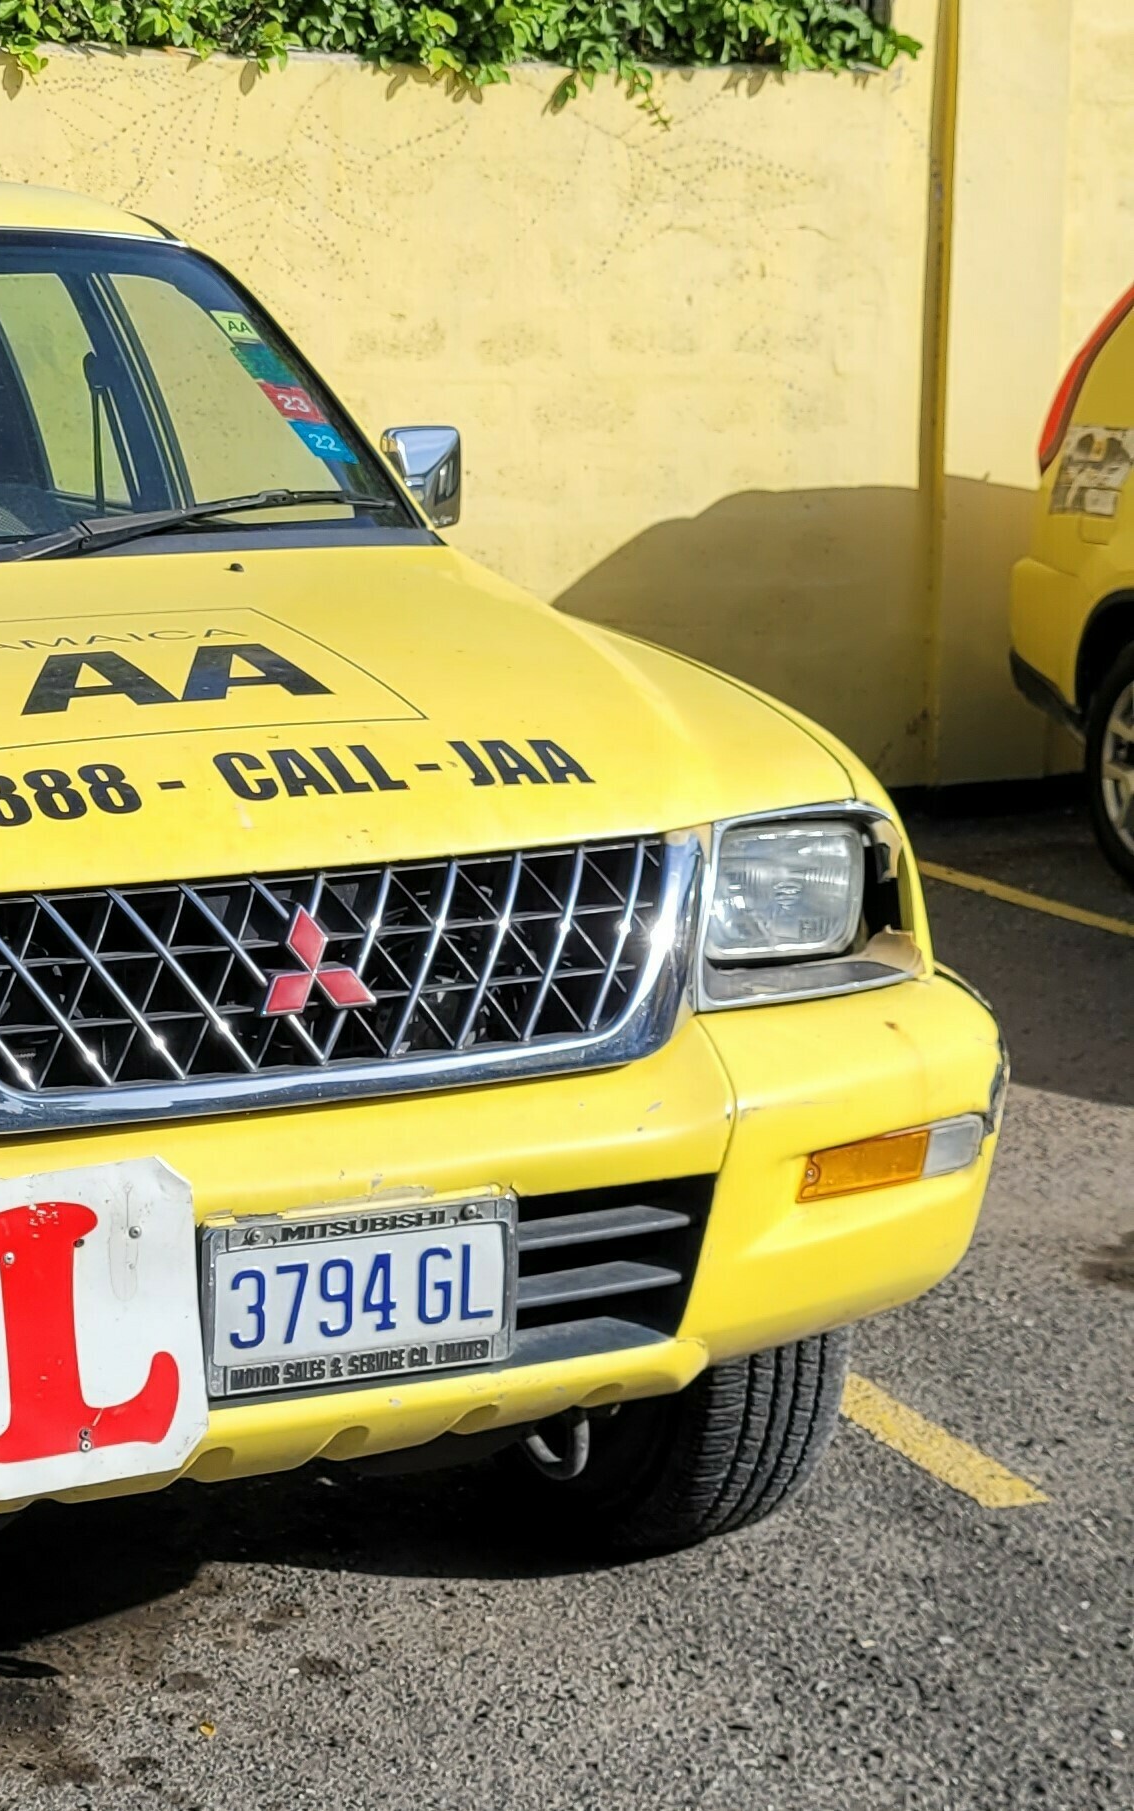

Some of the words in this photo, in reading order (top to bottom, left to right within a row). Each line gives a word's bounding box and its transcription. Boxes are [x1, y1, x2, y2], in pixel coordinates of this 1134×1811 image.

[228, 320, 253, 334] AA
[277, 394, 310, 412] 23
[308, 433, 341, 451] 22
[20, 644, 336, 716] AA
[281, 1210, 446, 1242] MITSUBISHI
[229, 1252, 397, 1350] 3794
[417, 1243, 494, 1325] GL
[230, 1365, 279, 1390] MOTOR
[282, 1359, 325, 1383] SALES
[330, 1356, 343, 1378] &
[347, 1348, 405, 1375] SERVICE
